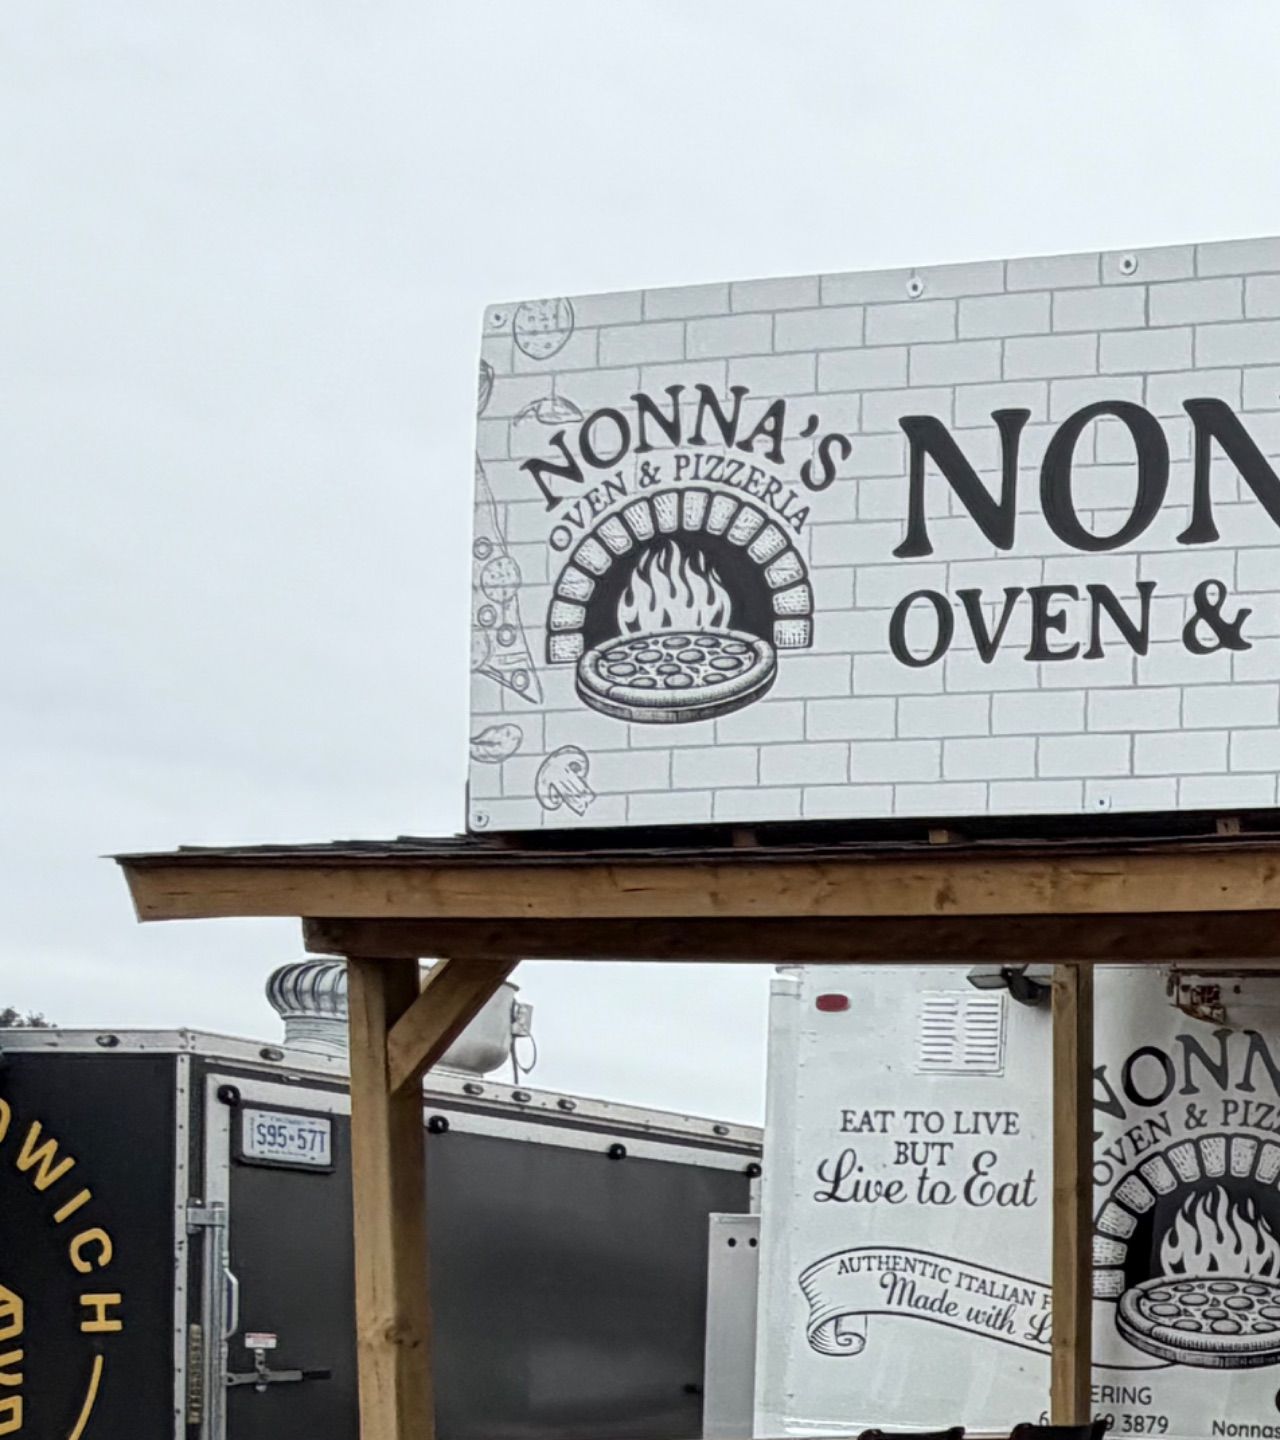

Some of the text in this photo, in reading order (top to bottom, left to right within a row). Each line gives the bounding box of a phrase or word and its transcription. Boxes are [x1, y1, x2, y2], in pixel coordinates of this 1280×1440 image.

[519, 384, 852, 512] NONNA'S
[549, 453, 811, 552] OVEN & PIZZERIA
[889, 582, 1157, 667] OVEN
[1182, 579, 1253, 654] &
[840, 1110, 1020, 1135] EAT TO LIVE
[1092, 1111, 1172, 1186] OVEN
[1184, 1102, 1208, 1130] &
[814, 1148, 1038, 1207] Live to Eat
[893, 1141, 954, 1166] BUT
[837, 1255, 952, 1284] AUTHENTIC
[955, 1272, 1037, 1306] ITALIAN
[879, 1271, 959, 1317] Made
[966, 1303, 1017, 1335] with
[1089, 1385, 1153, 1405] ERING
[1121, 1414, 1169, 1433] 3879
